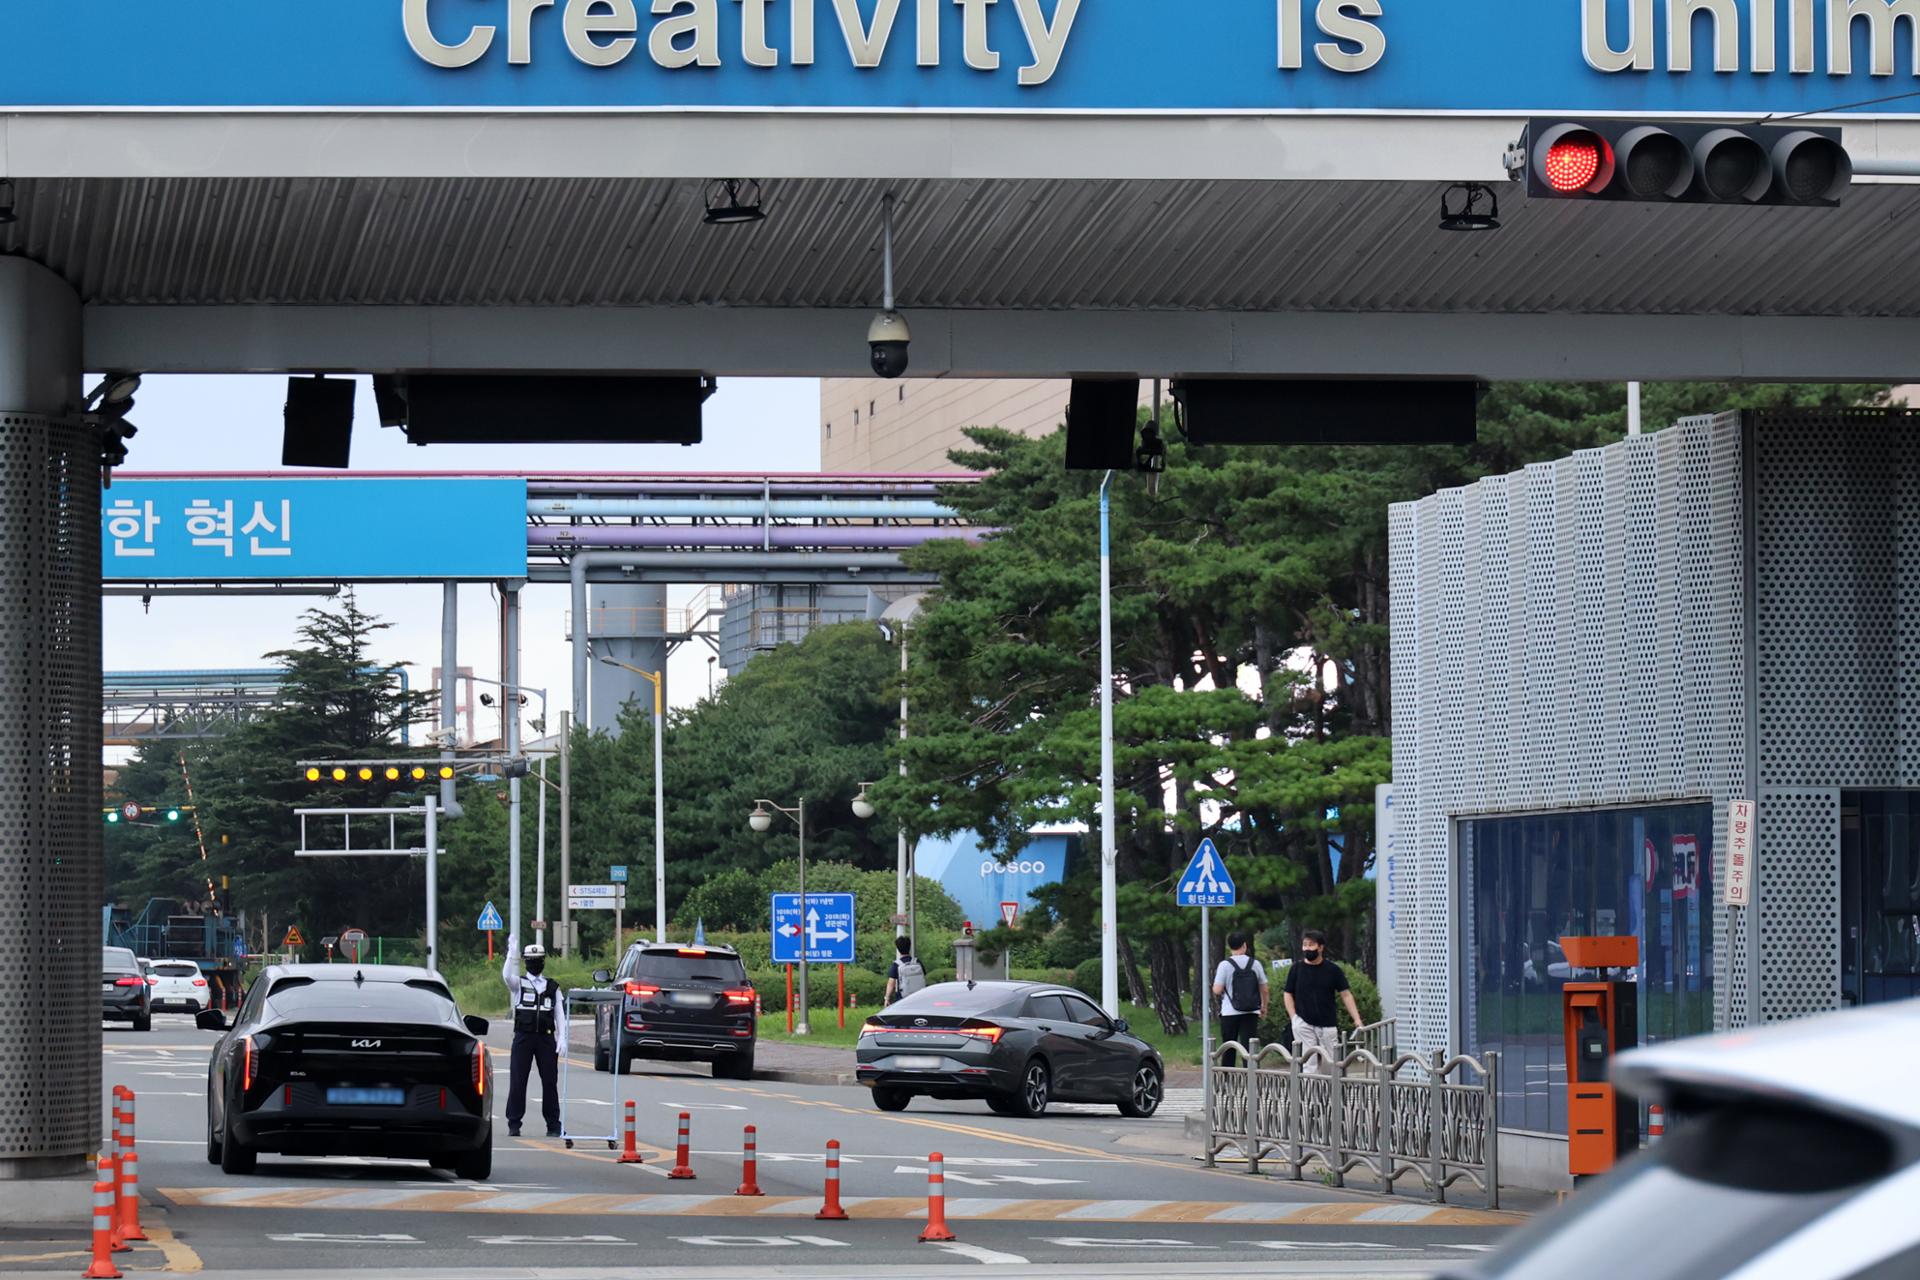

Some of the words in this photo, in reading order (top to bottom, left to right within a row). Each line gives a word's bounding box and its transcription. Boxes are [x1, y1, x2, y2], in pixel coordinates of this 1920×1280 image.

[402, 0, 1080, 85] Creativity
[102, 500, 160, 556] 한
[184, 500, 291, 557] 혁신
[981, 861, 1045, 877] posco
[1730, 804, 1748, 899] 차량추돌주의
[1189, 894, 1225, 904] 횡단보도
